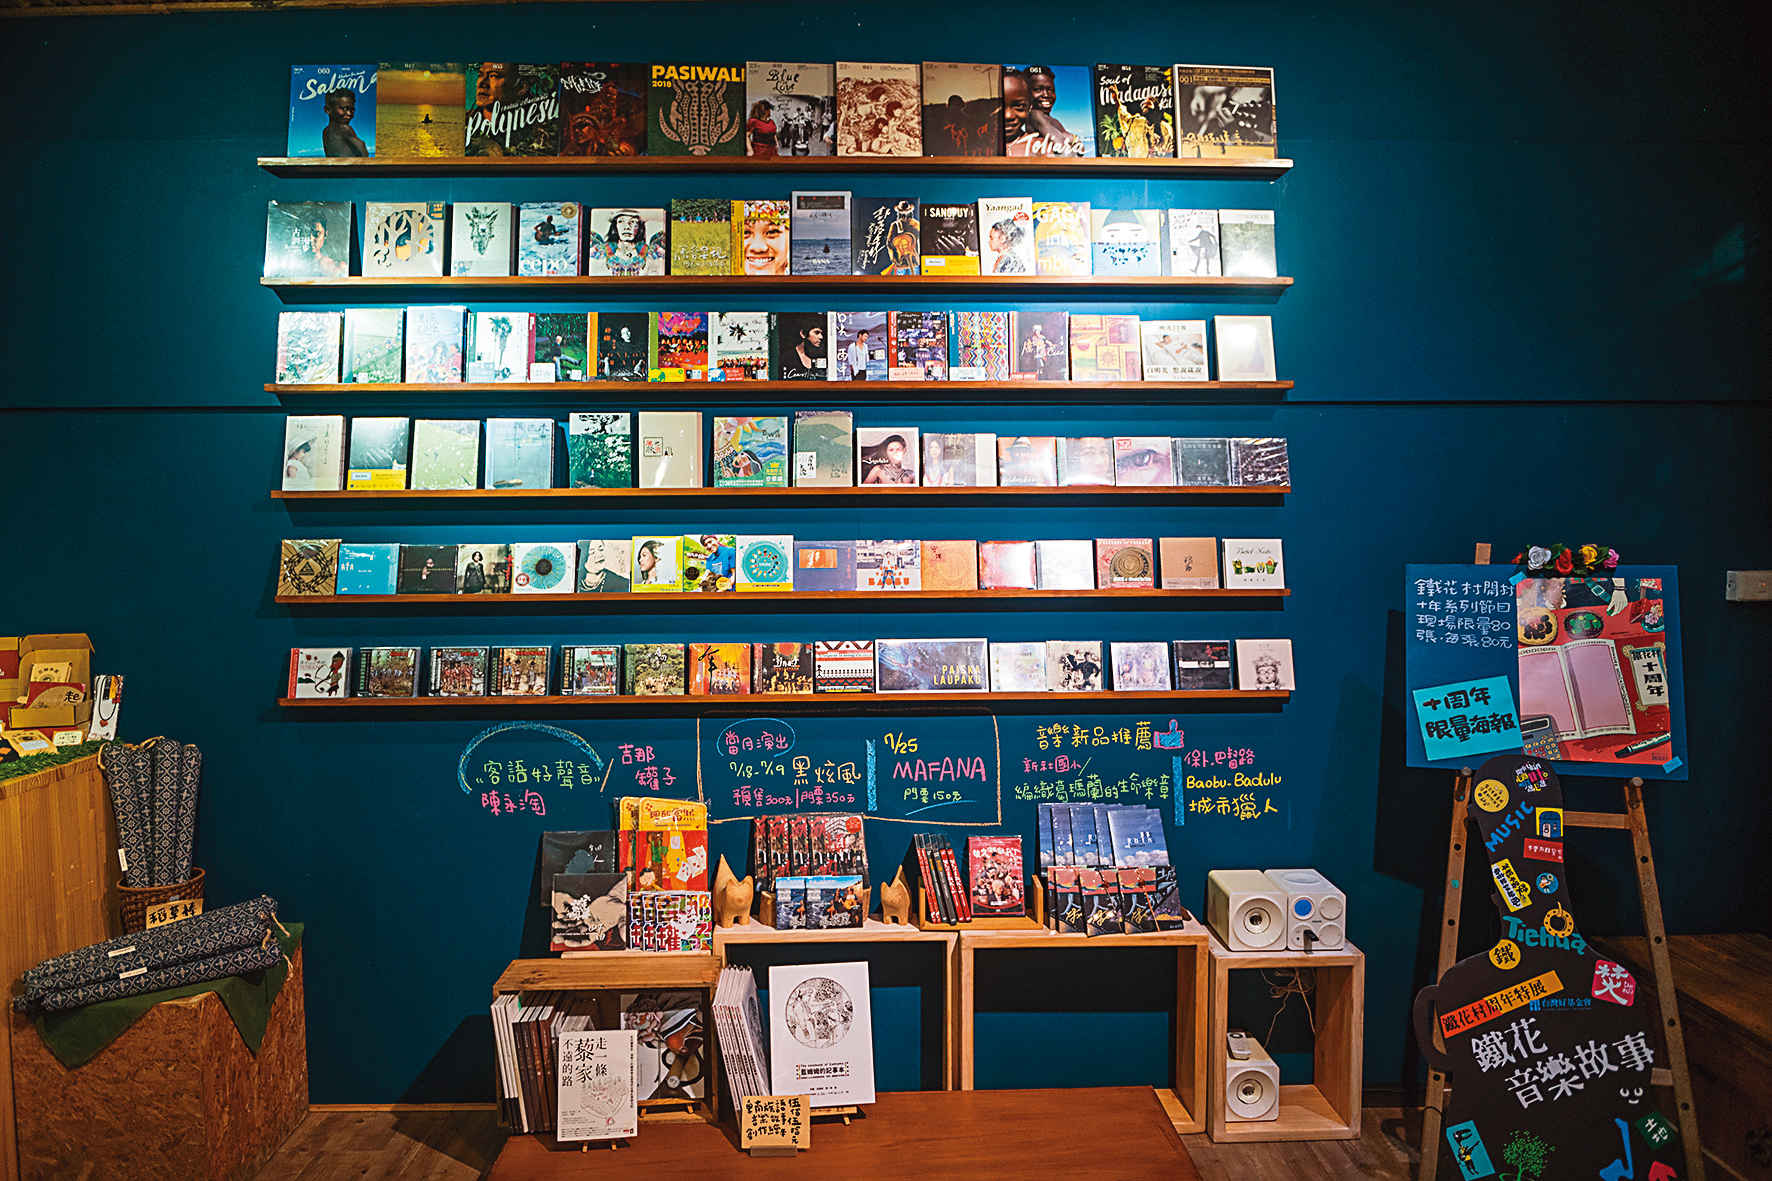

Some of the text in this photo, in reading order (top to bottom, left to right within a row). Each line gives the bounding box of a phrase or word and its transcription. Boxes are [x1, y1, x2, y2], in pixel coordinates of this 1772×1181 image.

[1100, 75, 1131, 85] Soul of
[985, 203, 1024, 212] Yaangad
[1037, 206, 1087, 224] GAGA
[933, 675, 982, 686] LAUPAKU
[942, 664, 981, 675] PAISKA
[1422, 687, 1491, 710] 十周年
[1425, 712, 1517, 743] 限量海報
[884, 732, 918, 754] 7/25
[893, 756, 986, 782] MAFANA
[1484, 800, 1535, 853] MUSIC
[1502, 915, 1588, 956] Tiehua
[1471, 1017, 1549, 1073] 鐵花
[561, 1038, 574, 1087] 不遠的路
[1504, 1031, 1655, 1109] 音樂故事
